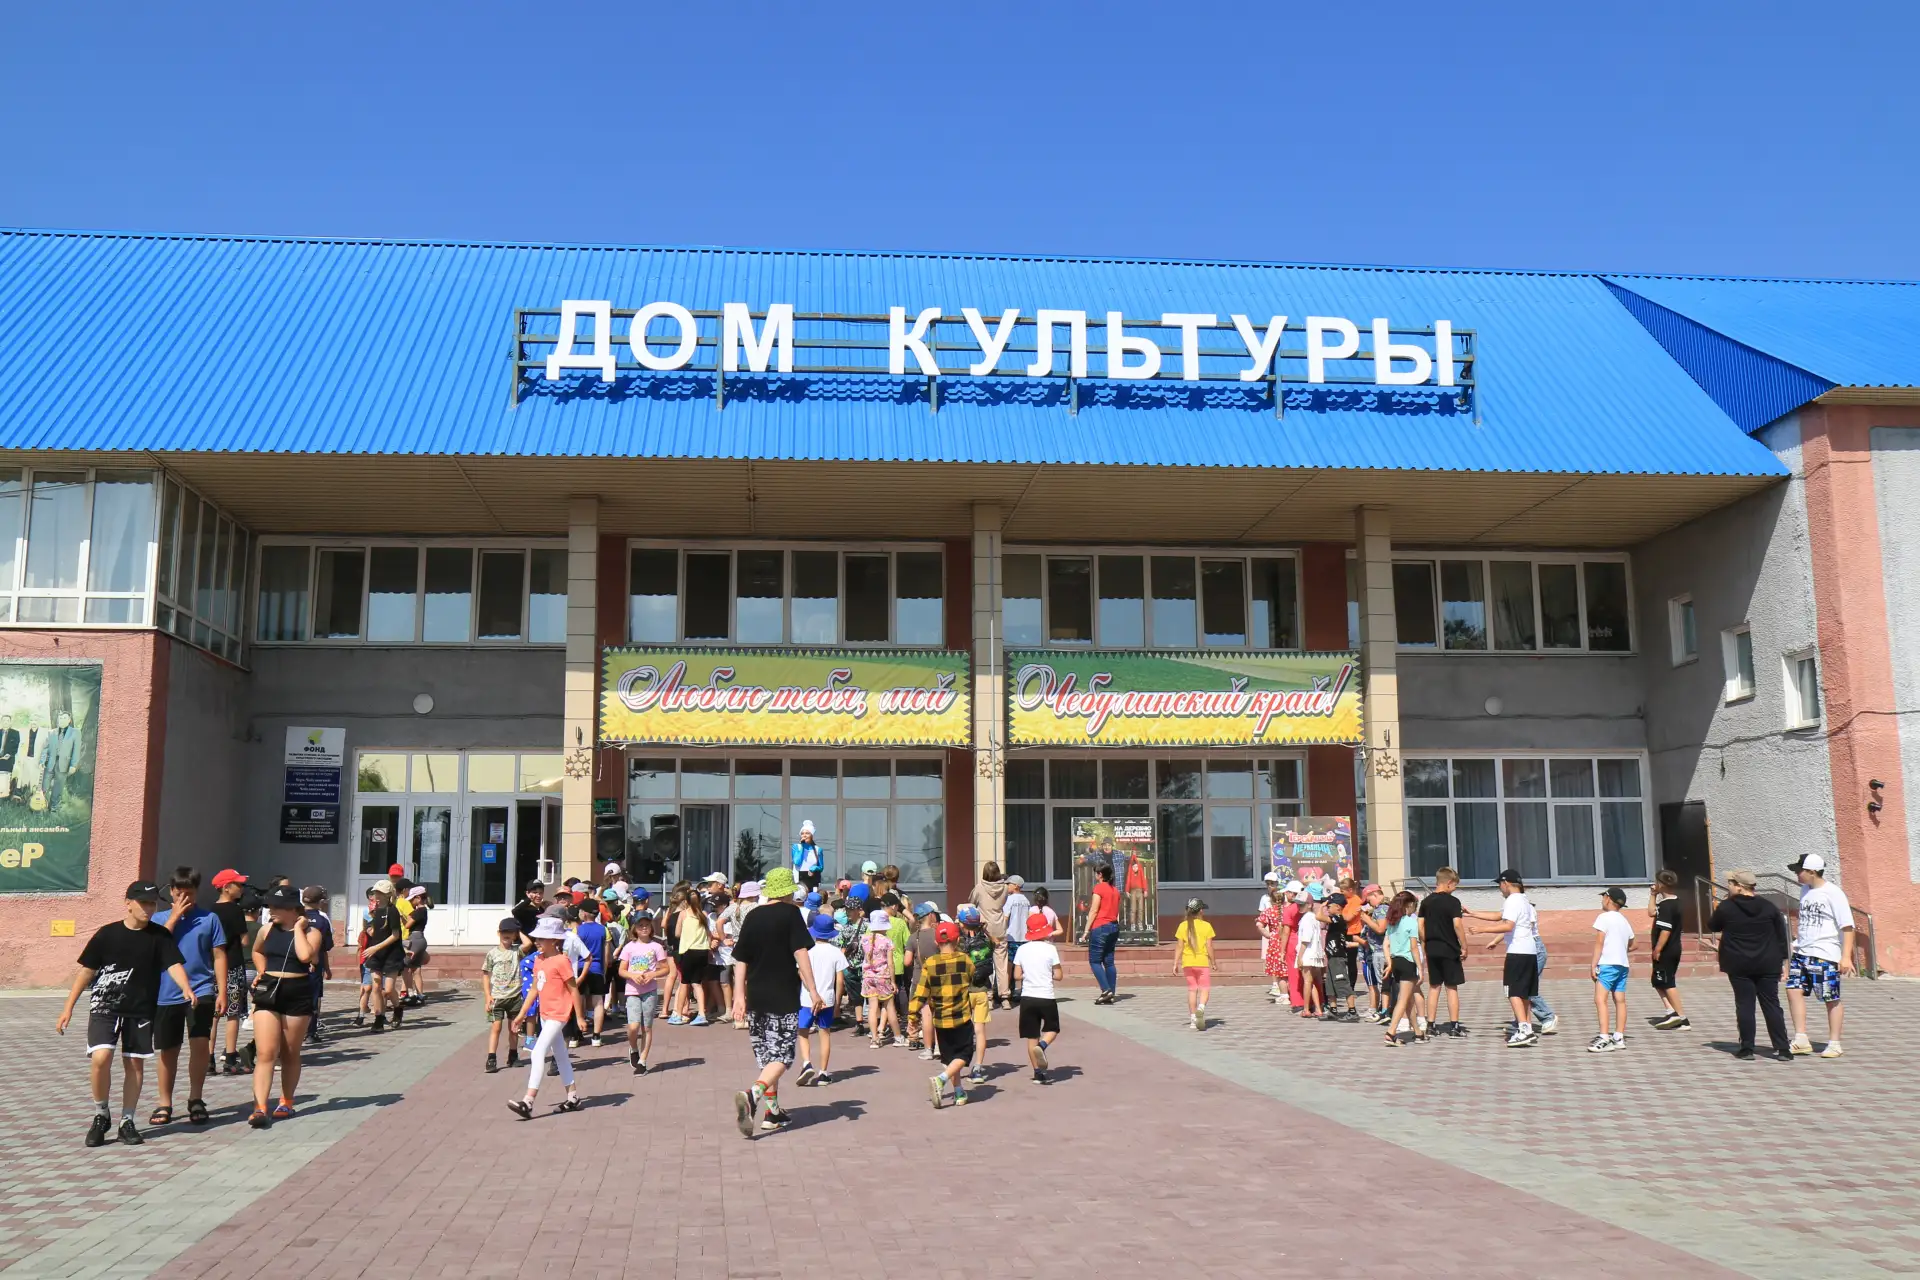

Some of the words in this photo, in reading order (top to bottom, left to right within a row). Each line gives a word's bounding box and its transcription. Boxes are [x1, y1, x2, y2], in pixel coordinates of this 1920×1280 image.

[546, 299, 794, 382] ДОМ
[889, 306, 1455, 387] КУЛЬТУРЫ
[617, 660, 771, 713] Люблю
[769, 667, 868, 719] тебя,
[878, 671, 958, 713] мой
[1016, 663, 1249, 736] Чебулинский
[1247, 662, 1354, 738] край!
[303, 746, 326, 754] ФОНД
[1114, 830, 1152, 838] ДЕДУШКЕ
